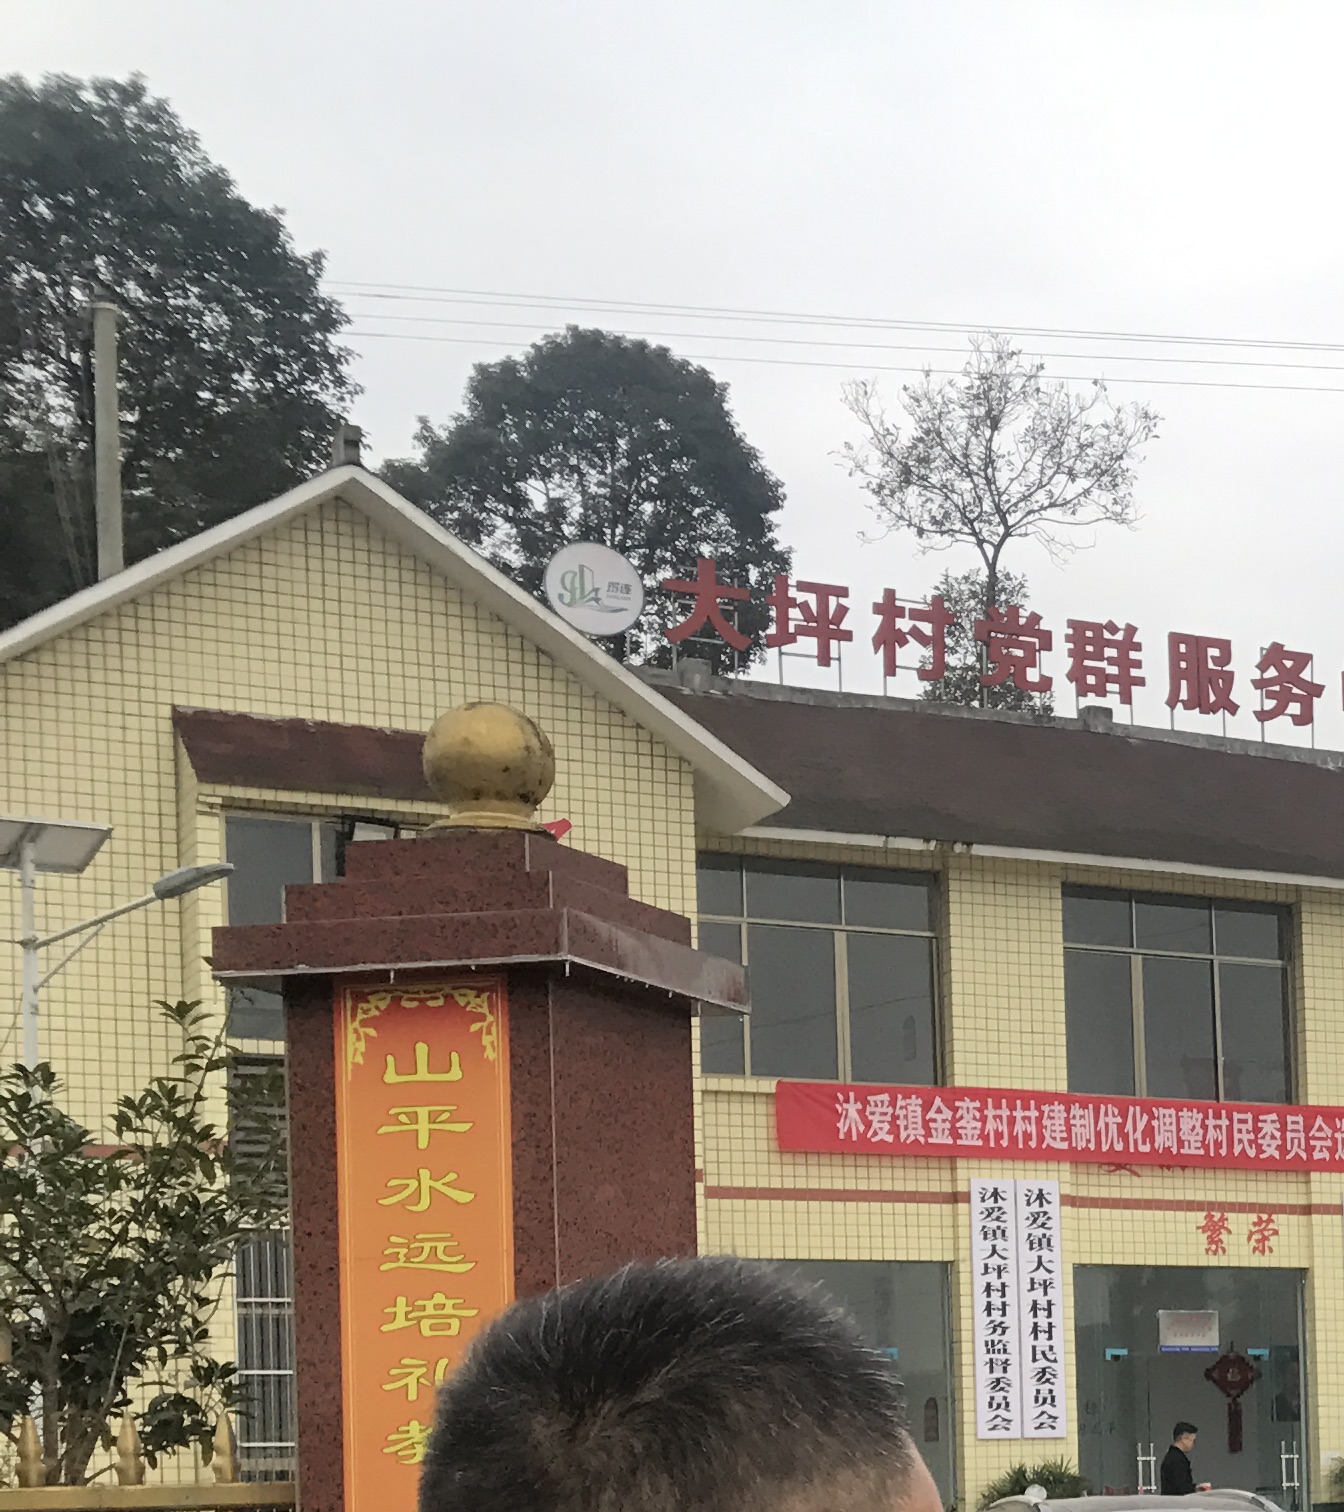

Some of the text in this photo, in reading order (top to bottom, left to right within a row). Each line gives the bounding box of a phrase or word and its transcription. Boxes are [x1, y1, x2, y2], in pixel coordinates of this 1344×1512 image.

[978, 1186, 1014, 1432] 沐爱镇大坪村村务监督委员会
[1024, 1187, 1060, 1431] 沐爱镇大坪村村民委员会
[1195, 1211, 1280, 1256] 繁荣
